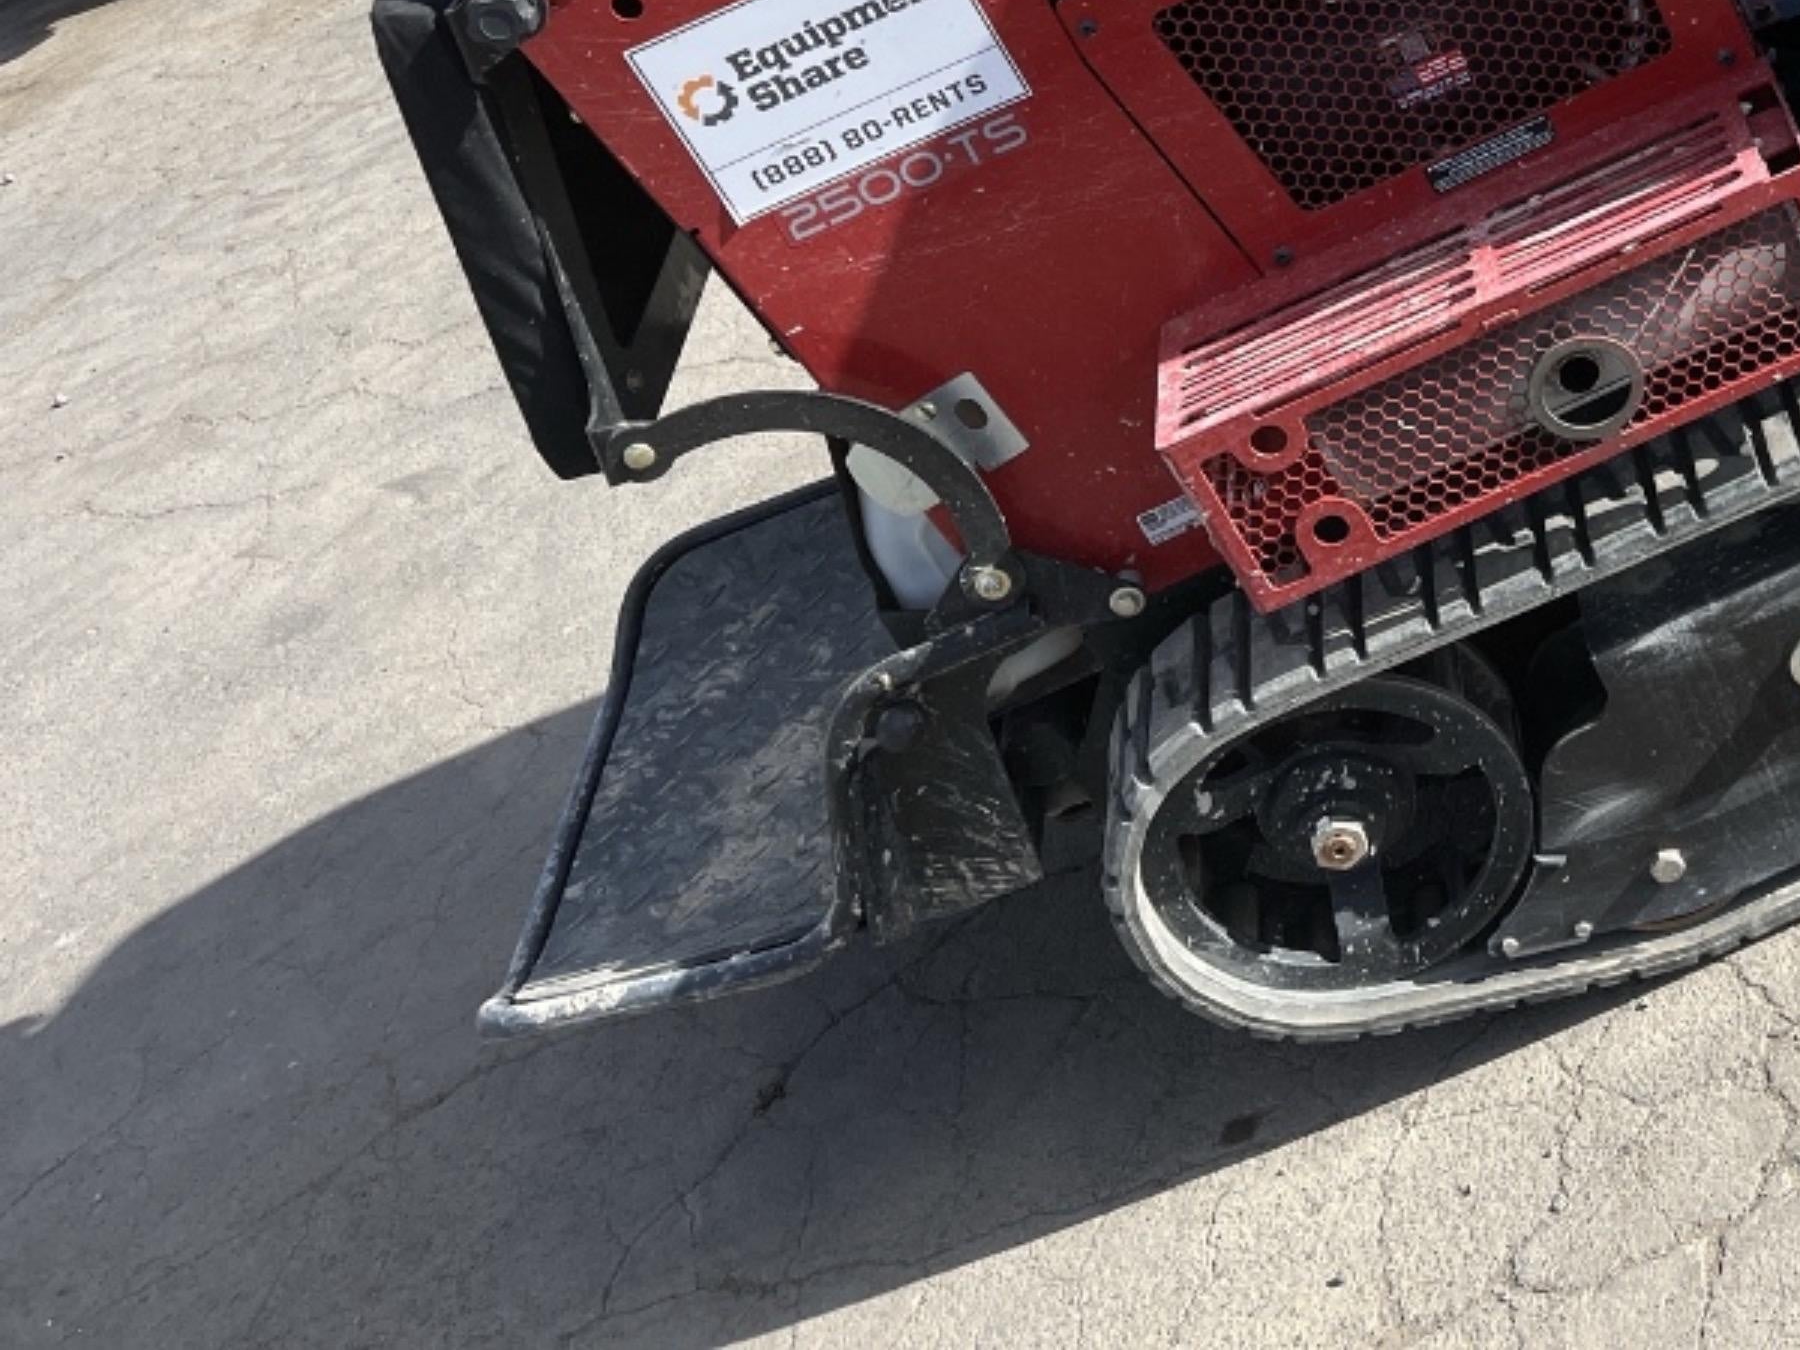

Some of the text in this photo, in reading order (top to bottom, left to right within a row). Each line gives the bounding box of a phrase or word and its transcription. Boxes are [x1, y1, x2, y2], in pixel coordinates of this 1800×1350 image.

[746, 46, 870, 113] Share
[749, 71, 989, 193] (888) 80-RENTS
